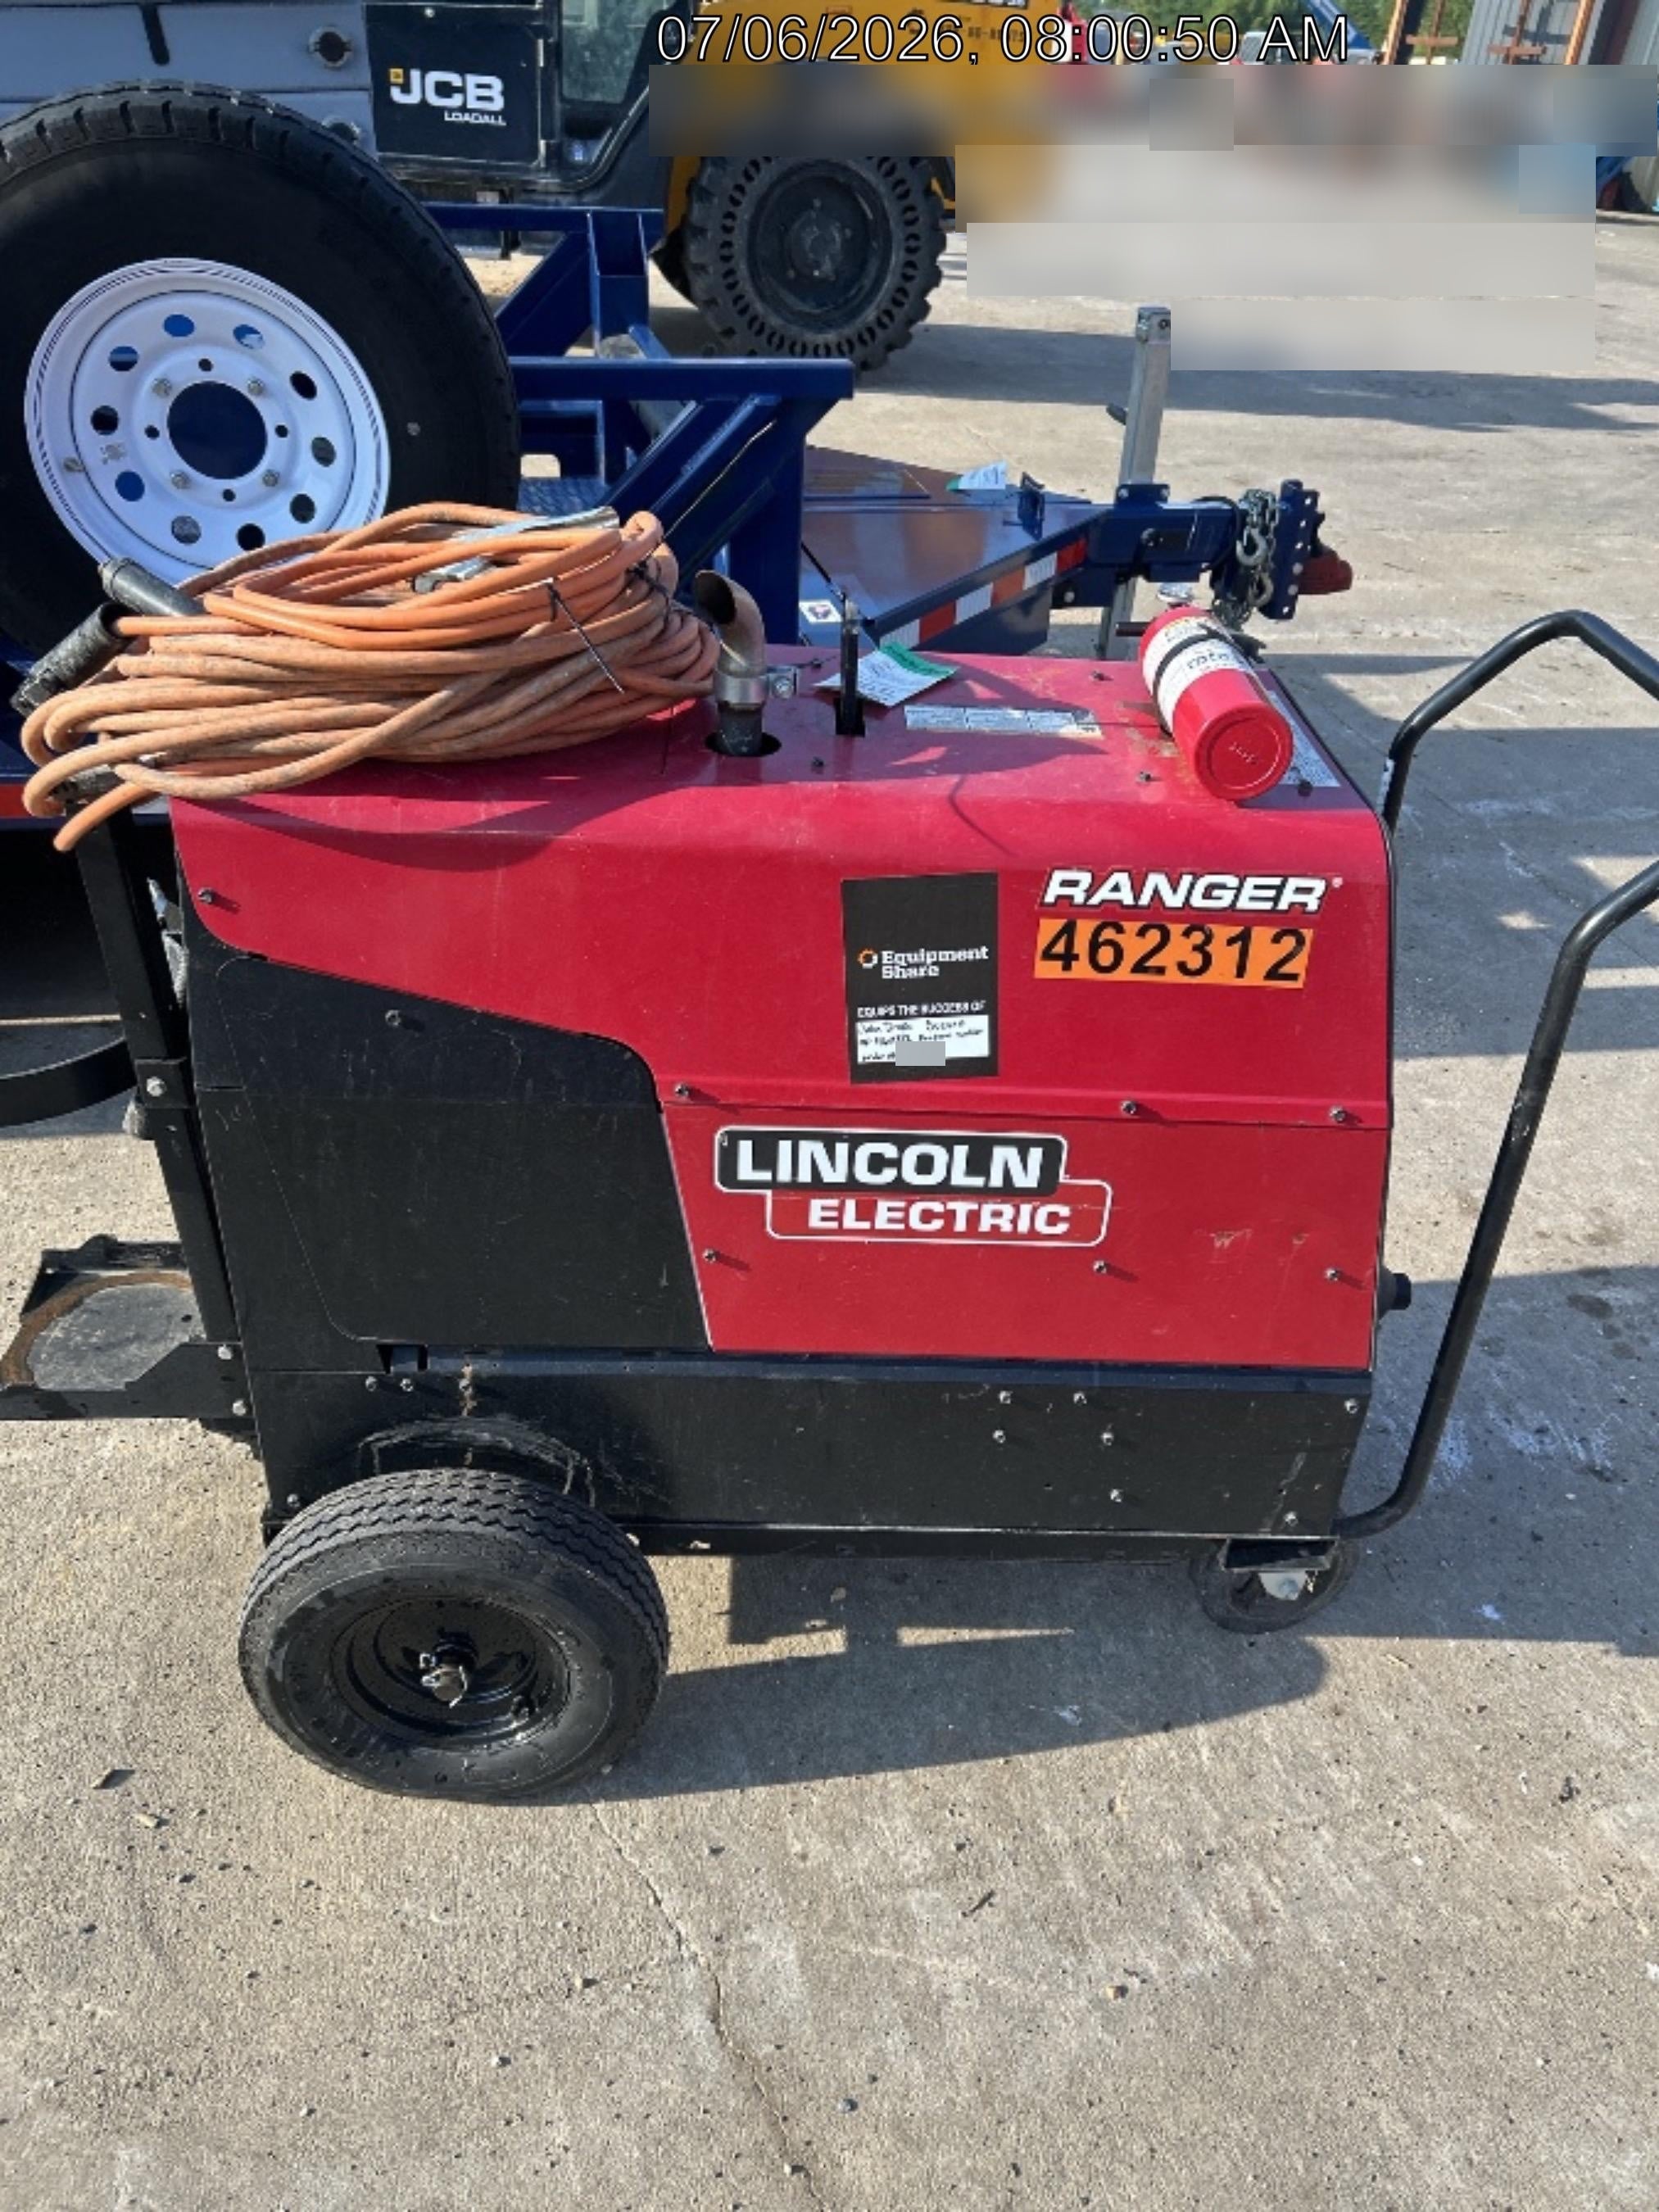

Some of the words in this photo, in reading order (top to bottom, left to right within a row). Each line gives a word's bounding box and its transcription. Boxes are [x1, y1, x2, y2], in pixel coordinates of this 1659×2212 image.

[389, 68, 505, 111] JCB
[444, 110, 507, 126] LOADALL
[1043, 868, 1326, 912] RANGER
[882, 945, 989, 967] Equipment
[1040, 919, 1308, 981] 462312
[882, 965, 940, 979] Share
[737, 1140, 1044, 1188] LINCOLN
[808, 1199, 1072, 1235] ELECTRIC
